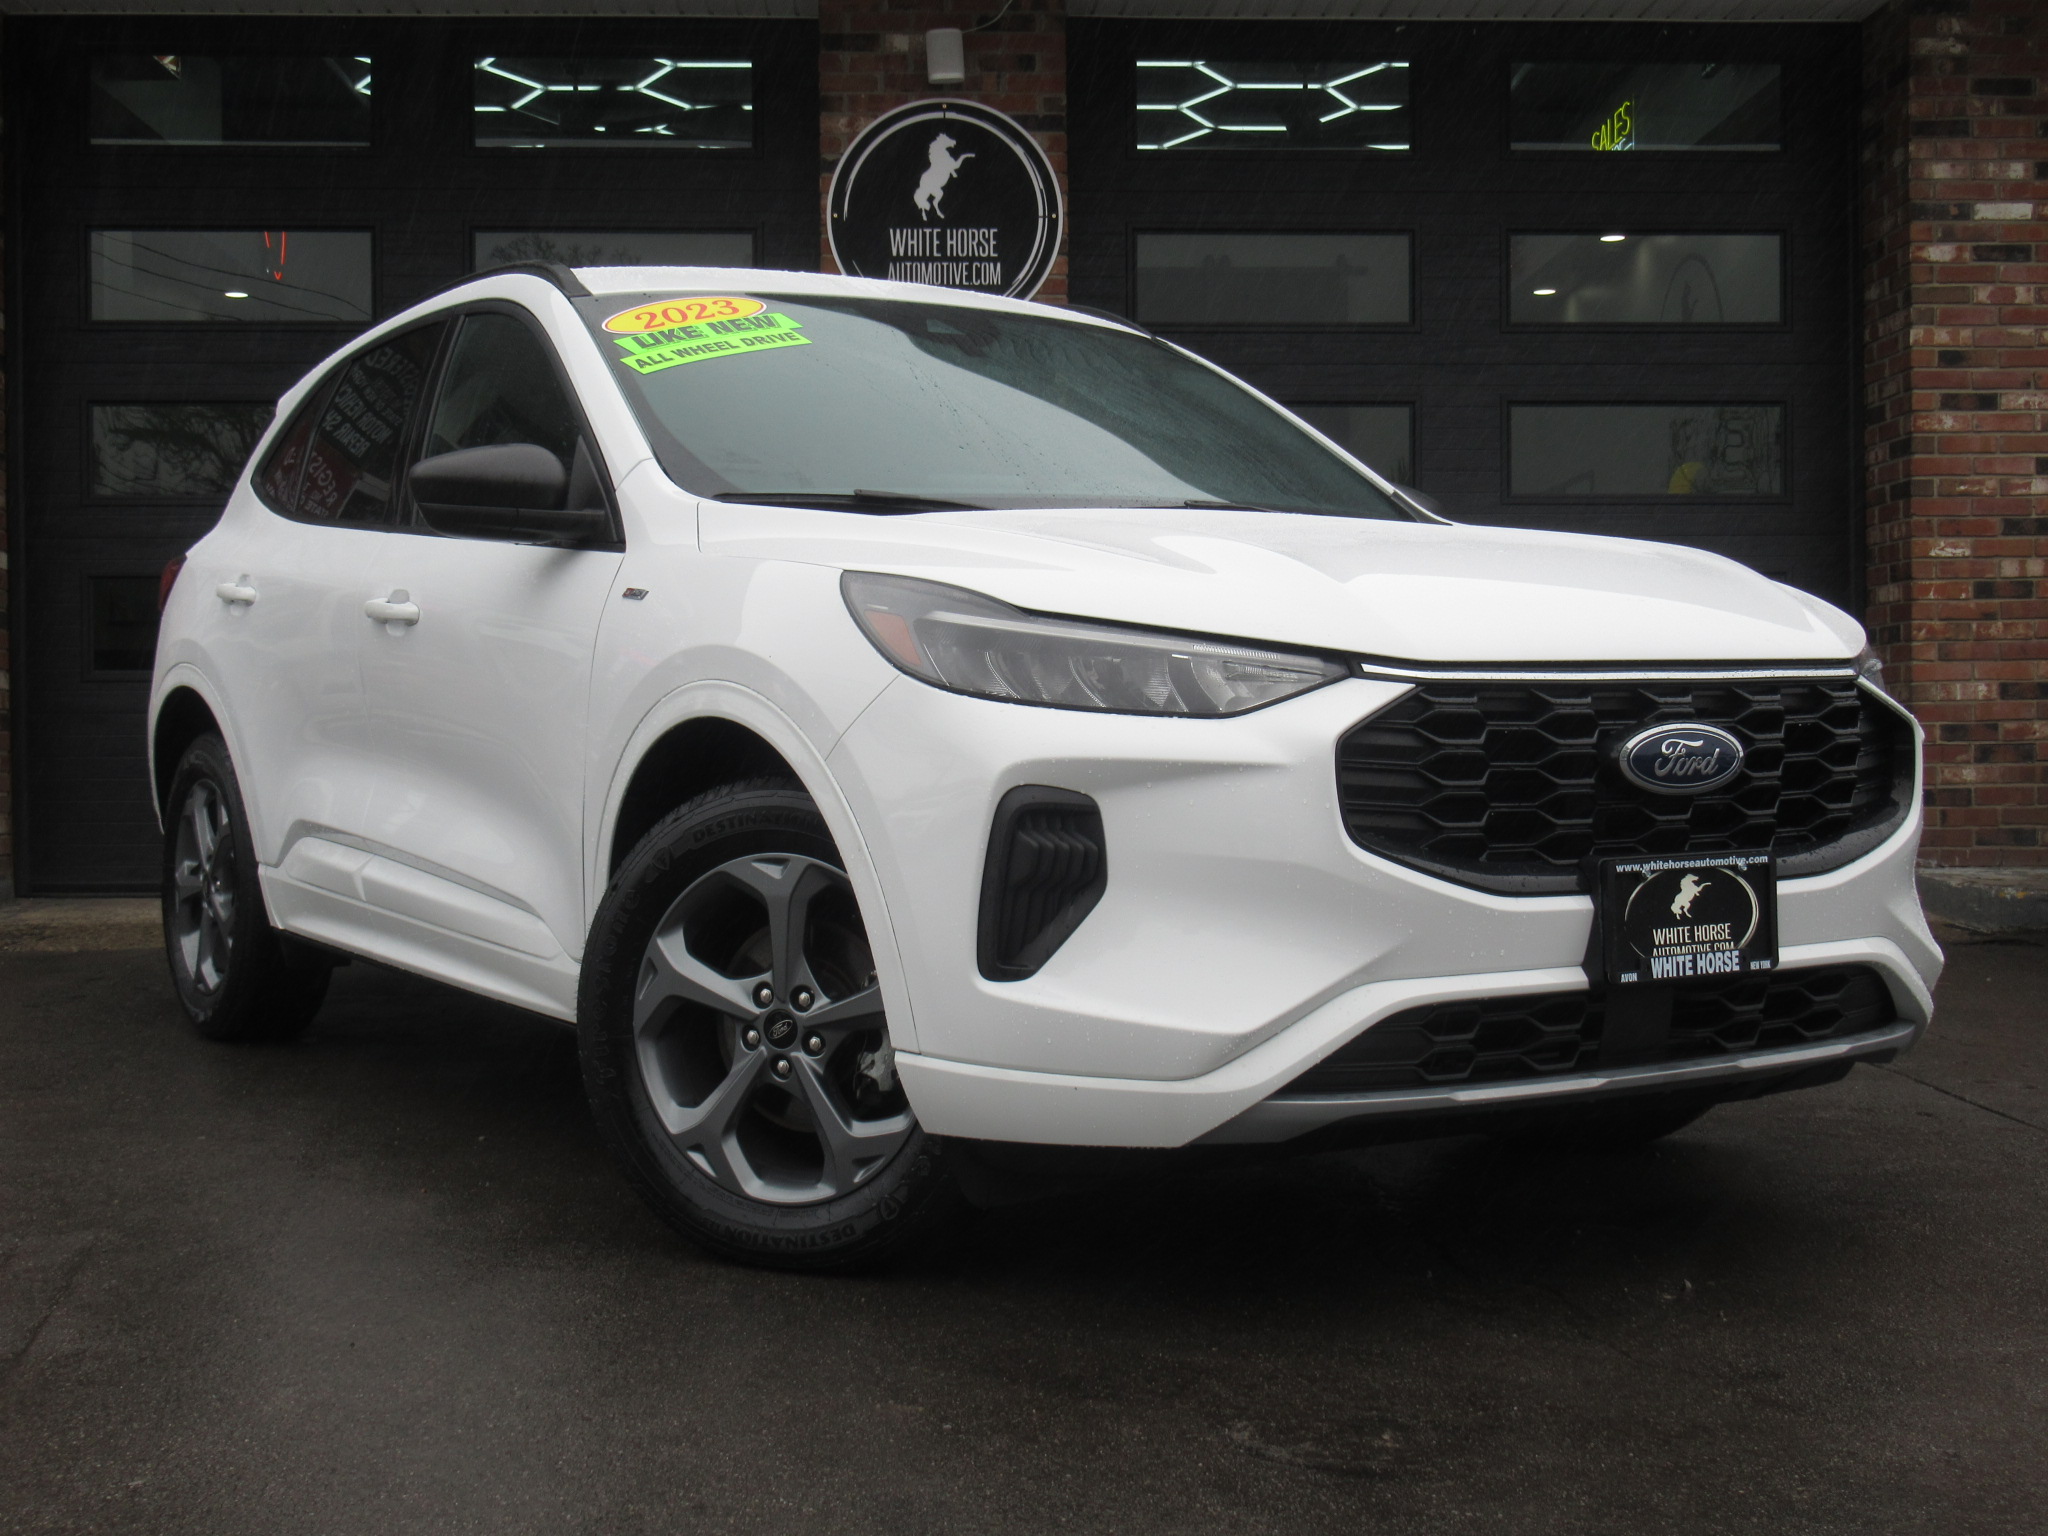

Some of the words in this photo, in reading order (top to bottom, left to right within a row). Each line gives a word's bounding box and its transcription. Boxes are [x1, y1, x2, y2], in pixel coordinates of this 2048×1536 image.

[1592, 101, 1631, 151] SALES
[889, 228, 942, 257] WHITE
[946, 228, 999, 257] HORSE
[888, 261, 1001, 286] AUTOMOTIVE.COM
[634, 300, 740, 330] 2023
[632, 325, 705, 350] LIKE
[707, 315, 778, 336] NEW
[635, 351, 674, 369] ALL
[677, 340, 740, 358] WHEEL
[740, 331, 801, 348] DRIVE
[1654, 738, 1720, 777] Ford
[1615, 855, 1769, 873] www.whitehorseautomotive.com
[1652, 926, 1691, 946] WHITE
[1694, 922, 1732, 942] HORSE
[1620, 972, 1638, 983] AVON
[1650, 954, 1693, 979] WHITE
[1697, 950, 1740, 975] HORSE
[1750, 961, 1760, 970] NEW
[1760, 959, 1771, 969] YORK
